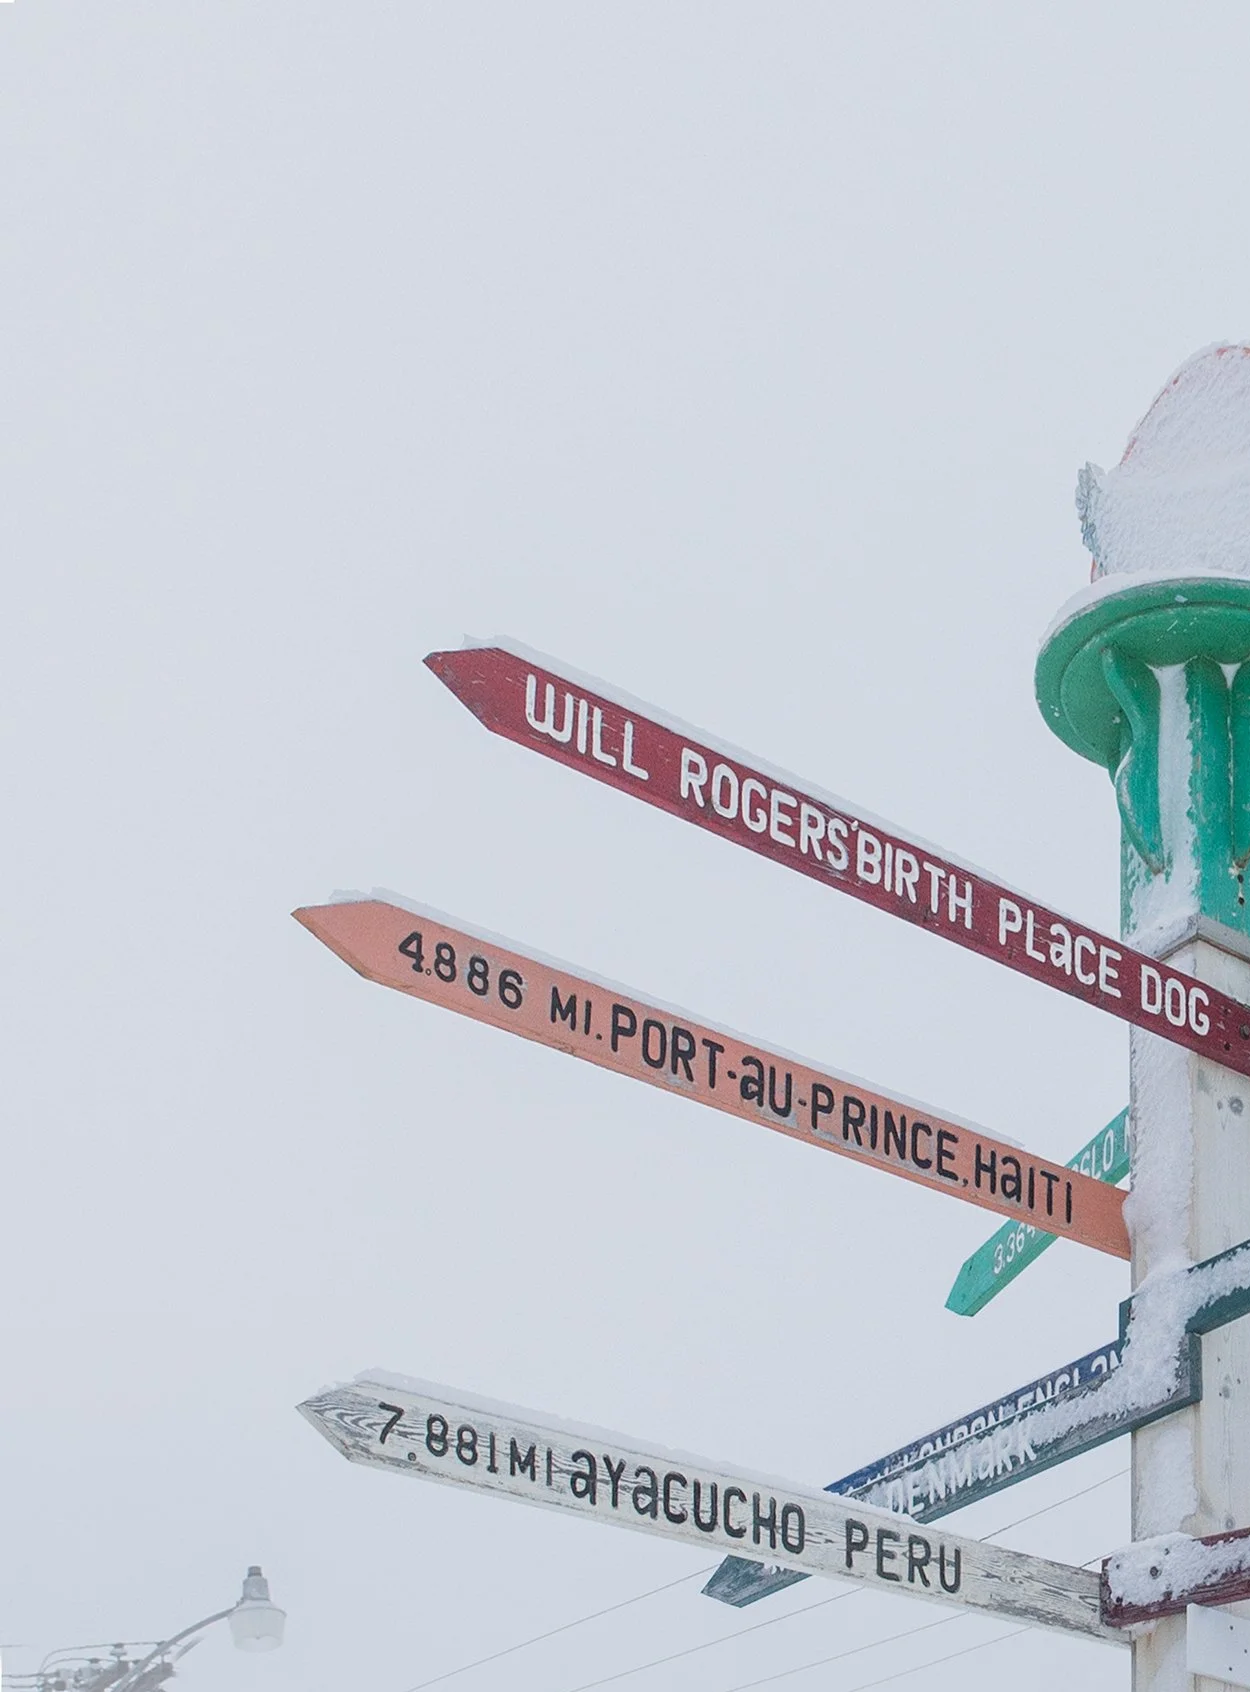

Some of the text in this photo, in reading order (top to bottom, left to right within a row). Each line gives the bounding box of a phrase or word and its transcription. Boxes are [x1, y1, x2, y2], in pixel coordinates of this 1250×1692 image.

[526, 674, 649, 781] WILL
[1140, 962, 1213, 1036] DOG
[398, 930, 523, 1009] 4.886
[844, 1518, 963, 1594] PERU
